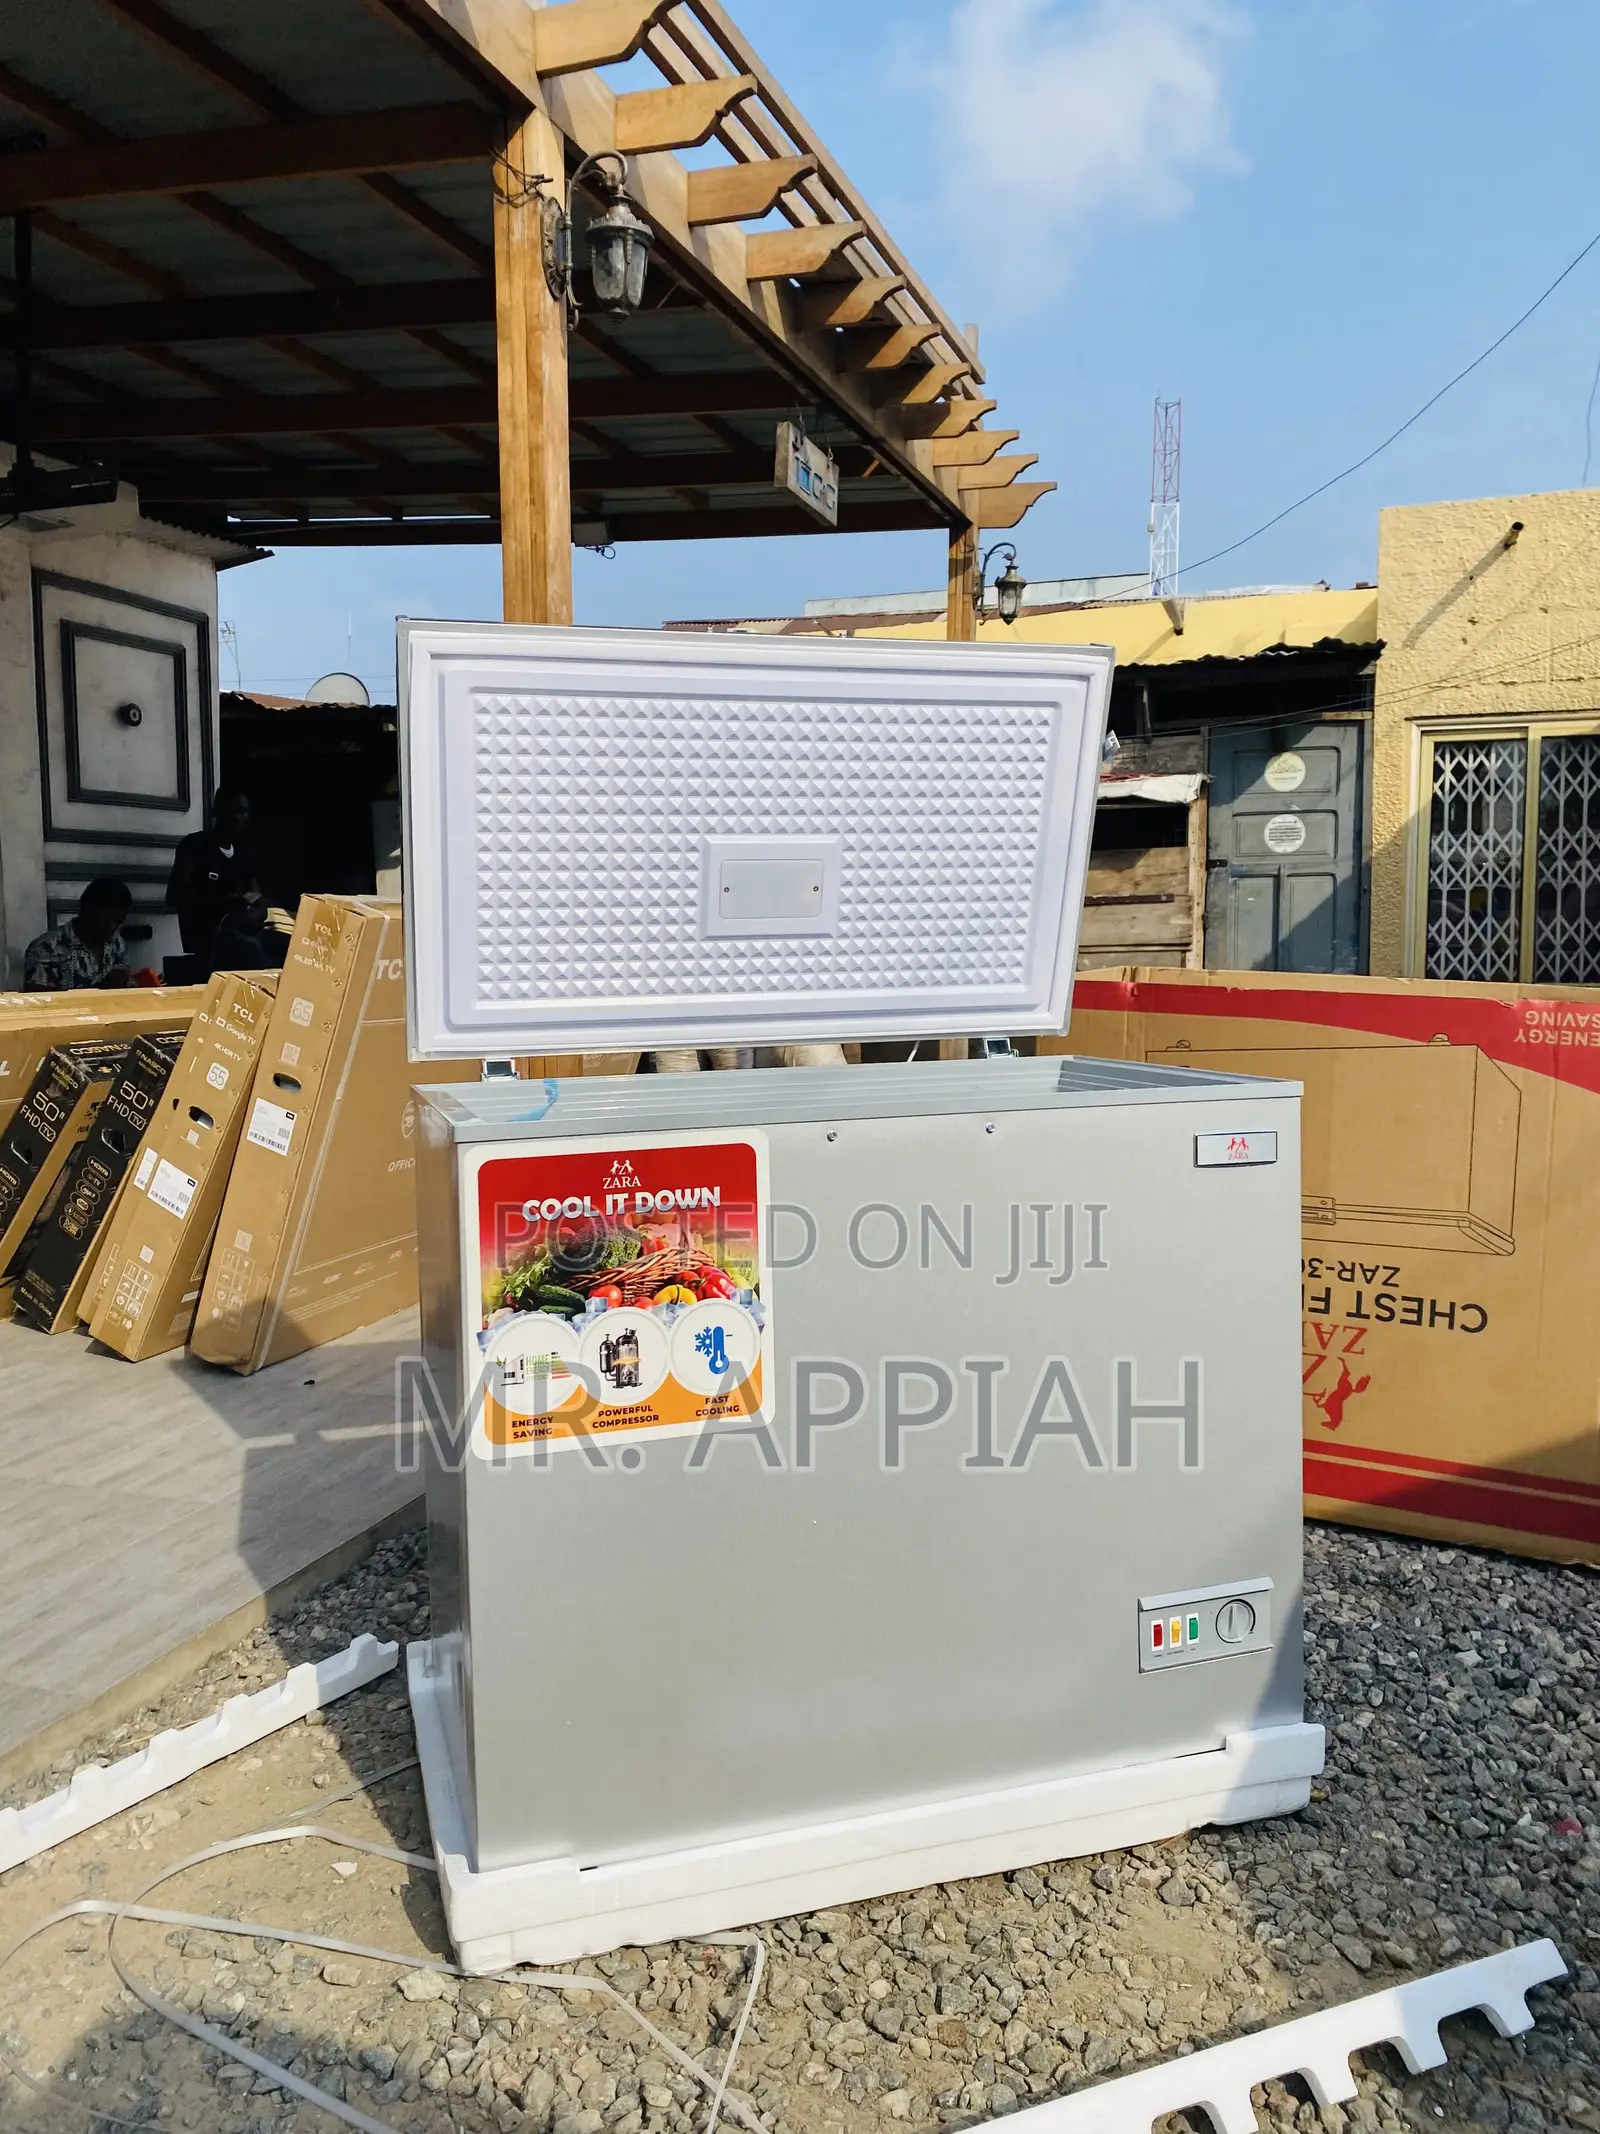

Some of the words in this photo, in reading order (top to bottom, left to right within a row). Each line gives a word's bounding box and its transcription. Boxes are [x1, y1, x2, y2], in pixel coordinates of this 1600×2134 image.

[314, 922, 333, 936] TCL
[376, 958, 404, 980] TC
[233, 1003, 255, 1023] TCL
[292, 1001, 313, 1023] 65
[226, 1023, 247, 1041] Google
[247, 1035, 257, 1046] TV
[69, 1044, 120, 1055] NASCO
[140, 1053, 167, 1076] NASCO
[54, 1065, 79, 1089] NASCO
[209, 1066, 228, 1087] 55
[120, 1080, 155, 1110] 50"
[20, 1105, 40, 1128] FHD
[33, 1091, 65, 1122] 50"
[107, 1095, 130, 1118] FHD
[132, 1114, 144, 1126] TV
[602, 1176, 641, 1190] ZARA
[521, 1195, 599, 1222] COOL
[605, 1193, 629, 1216] IT
[635, 1186, 721, 1214] DOWN
[1302, 1284, 1331, 1315] F
[1346, 1290, 1488, 1334] CHEST
[1302, 1321, 1368, 1355] ZA
[526, 1354, 550, 1366] HOME
[598, 1404, 654, 1417] POWERFUL
[695, 1404, 740, 1417] COOLING
[705, 1395, 730, 1405] FAST
[511, 1415, 554, 1428] ENERGY
[592, 1413, 660, 1429] COMPRESSOR
[513, 1426, 553, 1439] SAVING
